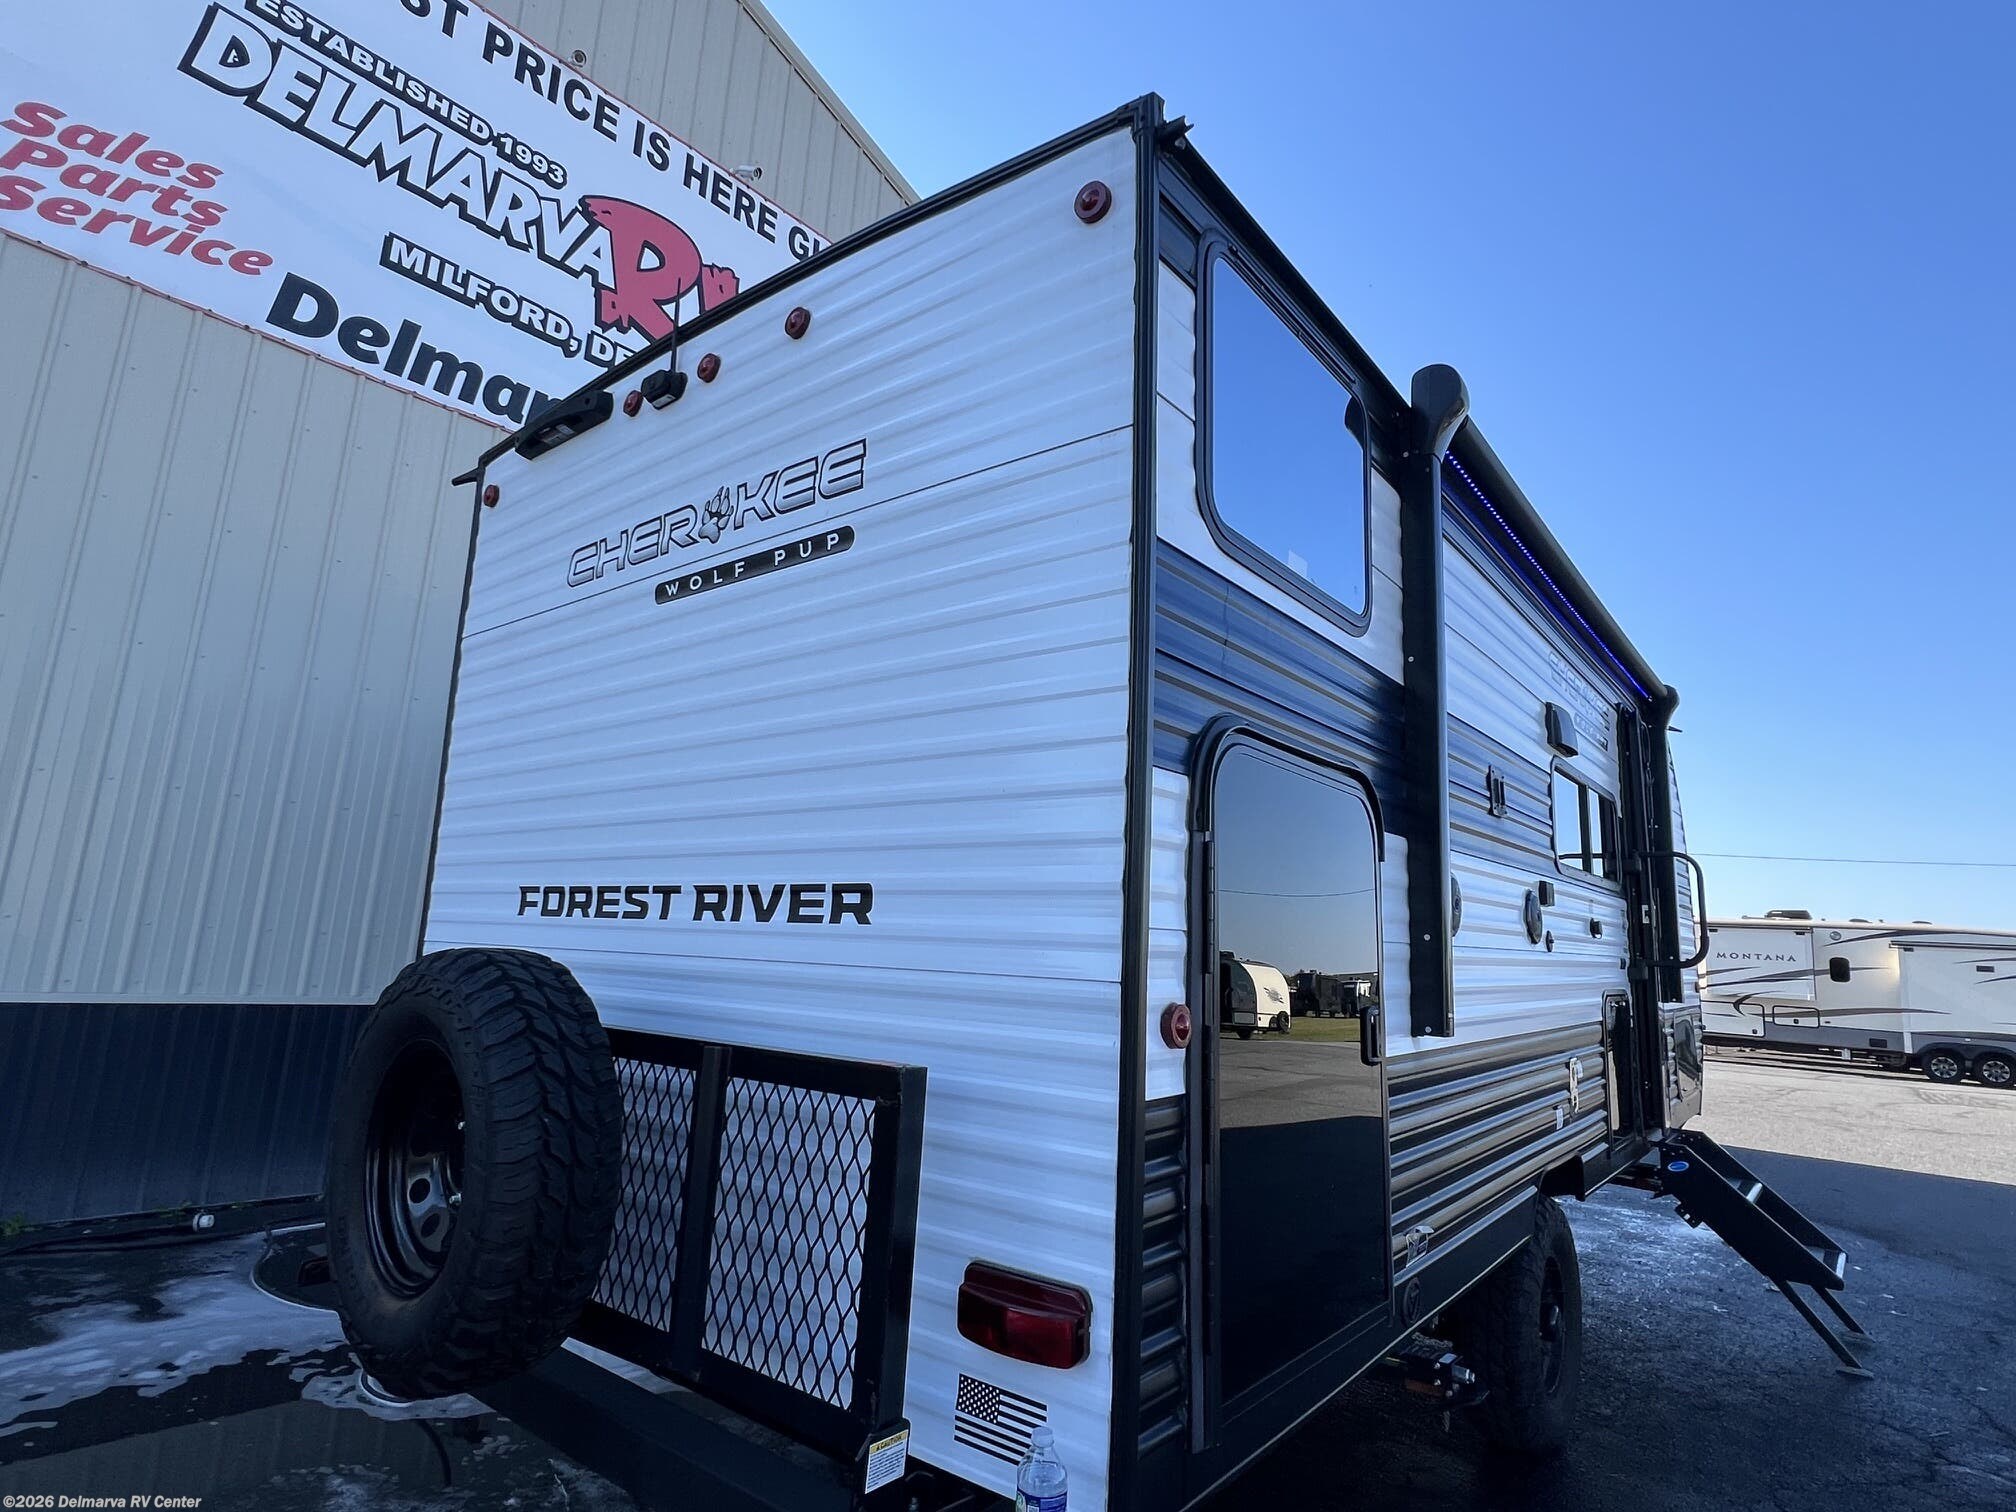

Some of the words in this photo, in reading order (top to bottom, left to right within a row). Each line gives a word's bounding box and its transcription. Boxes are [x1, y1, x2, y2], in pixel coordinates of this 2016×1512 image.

[247, 0, 492, 146] ESTABLISHED
[494, 132, 567, 189] 1993
[482, 21, 621, 142] PRICE
[633, 120, 671, 172] IS
[683, 154, 778, 244] HERE
[0, 101, 224, 189] Sales
[0, 138, 228, 227] Parts
[178, 2, 617, 292] DELMARVA
[0, 174, 274, 276] Service
[380, 232, 582, 358] MILFORD,
[665, 561, 745, 597] WOLF
[774, 532, 841, 567] PUP
[517, 885, 682, 920] FOREST
[692, 882, 873, 925] RIVER
[1716, 952, 1796, 962] MONTANA
